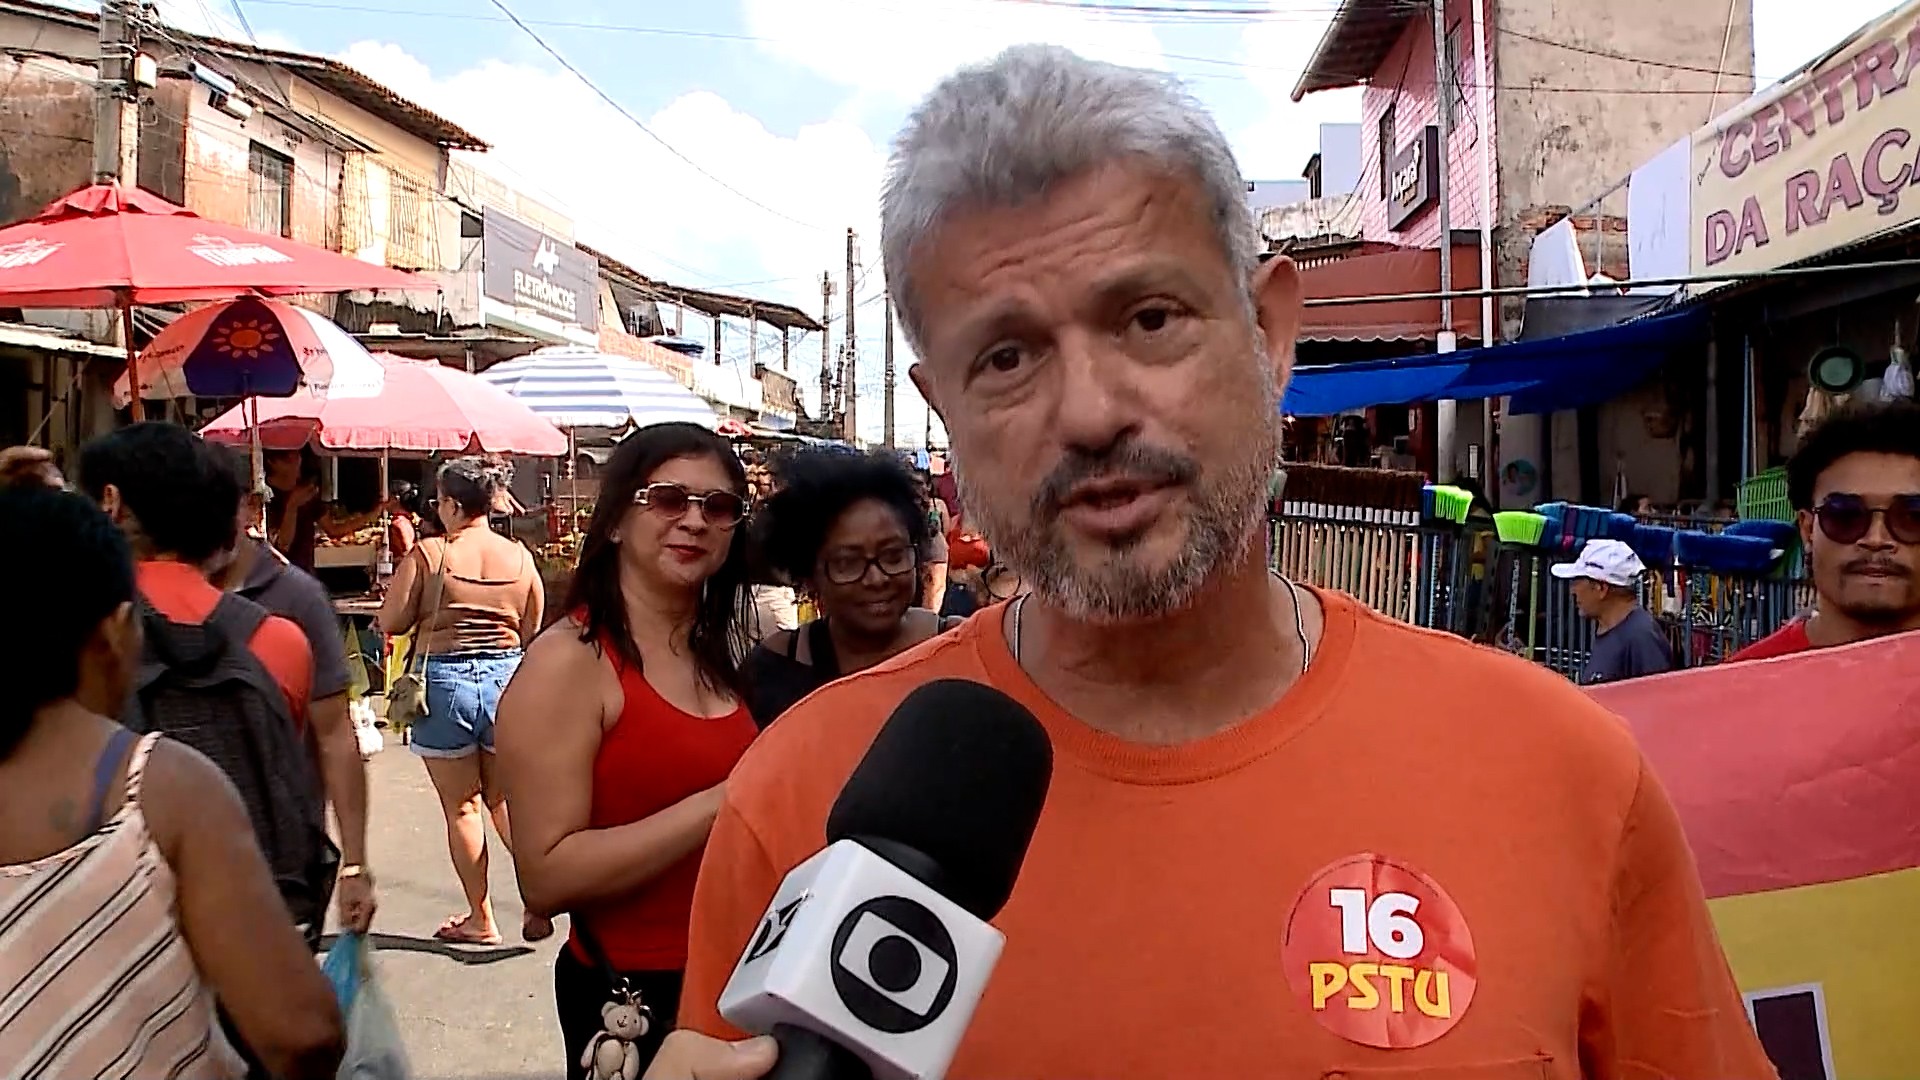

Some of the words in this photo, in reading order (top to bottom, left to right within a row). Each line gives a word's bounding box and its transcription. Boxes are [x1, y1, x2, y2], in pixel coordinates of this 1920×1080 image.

[1705, 195, 1769, 266] DA
[1785, 127, 1920, 235] RAÇ
[1328, 887, 1424, 959] 16
[1309, 961, 1450, 1018] PSTU
